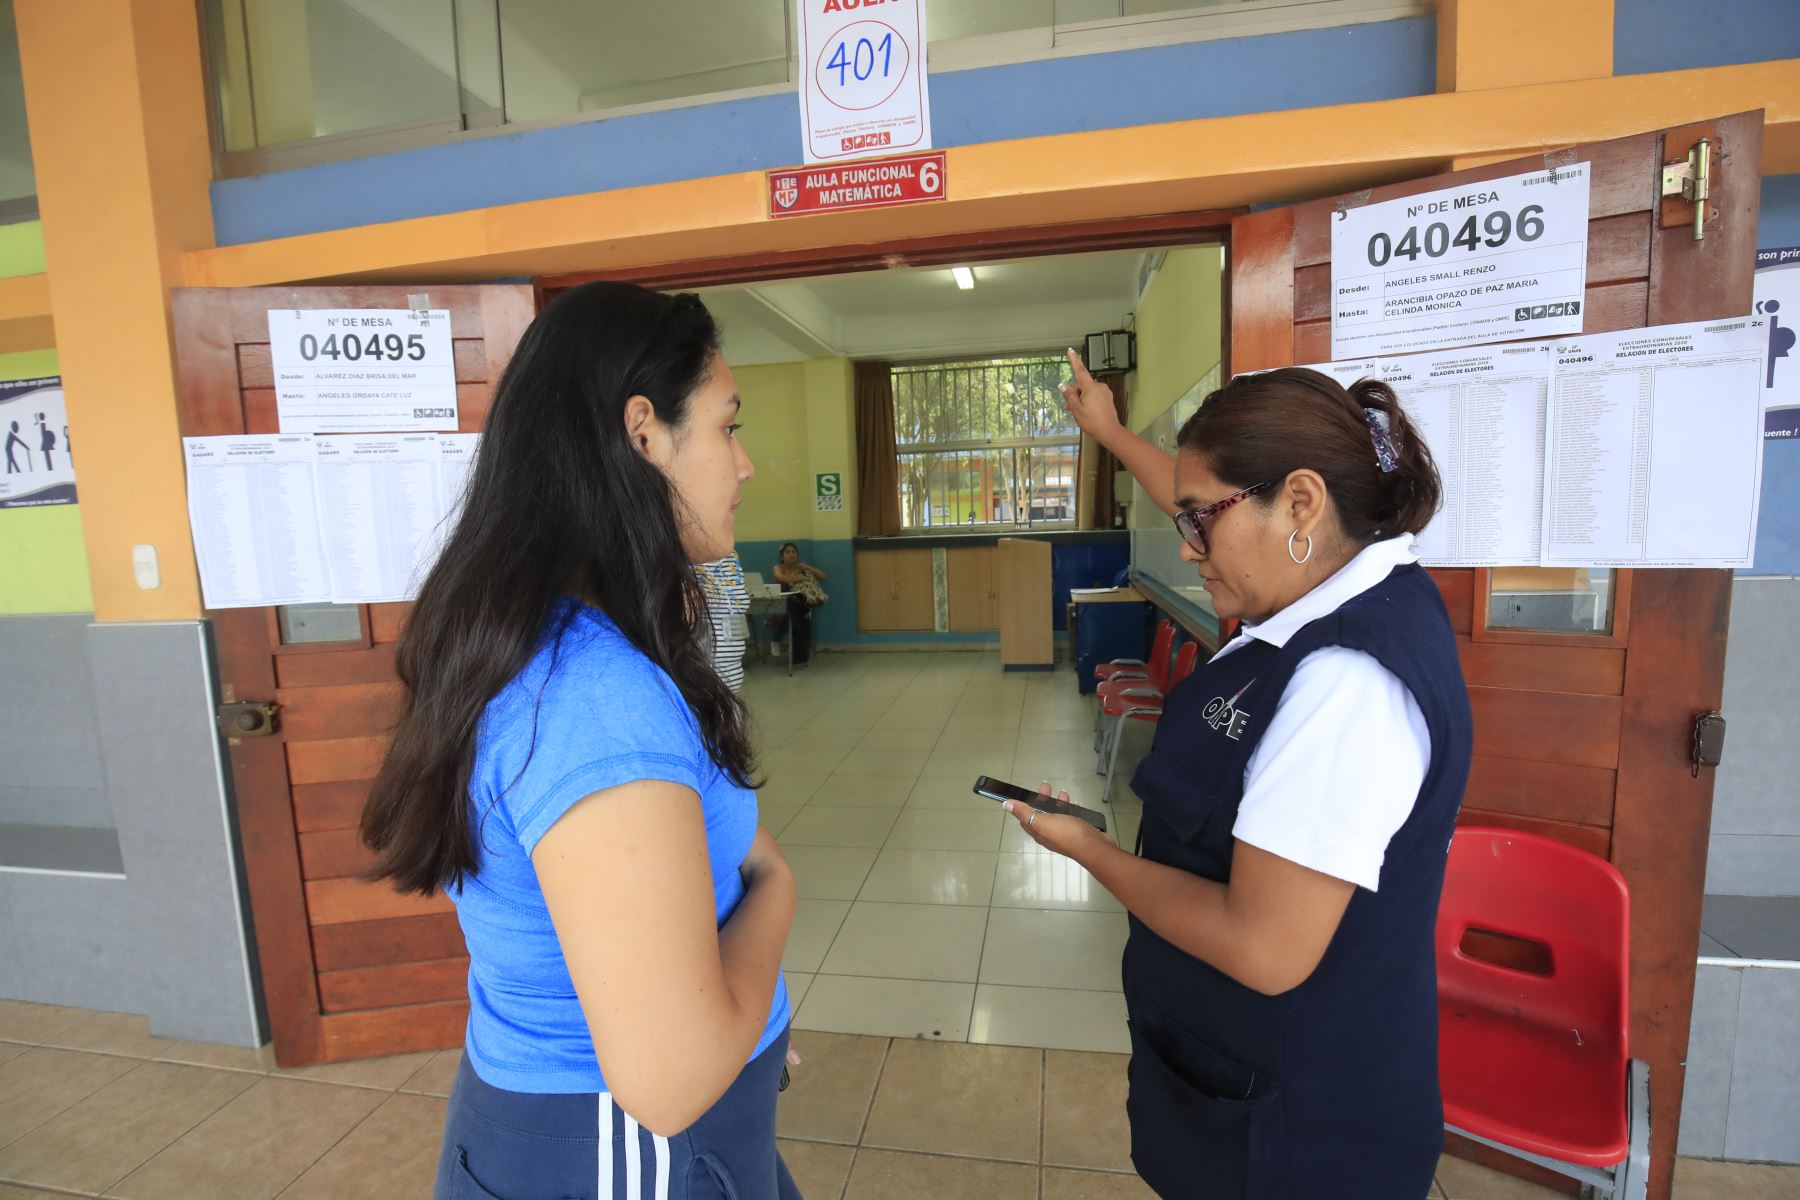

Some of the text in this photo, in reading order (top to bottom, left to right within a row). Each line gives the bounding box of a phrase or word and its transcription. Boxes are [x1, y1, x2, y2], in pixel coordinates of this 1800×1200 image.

[826, 32, 892, 87] 401
[805, 164, 915, 189] AULA FUNCIONAL
[919, 162, 940, 193] 6
[819, 183, 902, 205] MATEMÁTICA
[1428, 201, 1448, 215] DE
[1453, 191, 1500, 210] MESA
[1367, 204, 1545, 267] 040496
[1758, 252, 1777, 260] son
[1339, 264, 1496, 295] Desde: ANGELES SMALL RENZO
[1339, 278, 1539, 318] Hasta: ARANCIBIA OPAZO DE PAZ MARIA
[1385, 300, 1462, 317] CELINDA MONICA
[342, 318, 357, 327] DE
[361, 317, 393, 327] MESA
[300, 333, 426, 361] 040495
[1616, 349, 1646, 358] RELACION
[1658, 345, 1694, 354] ELECTORES
[1618, 335, 1692, 347] ELECCIONES CONGRESALES
[1465, 365, 1494, 373] ELECTORES
[1558, 355, 1594, 365] 040496
[1383, 375, 1412, 383] 040496
[1764, 429, 1792, 437] uente
[821, 474, 837, 495] S
